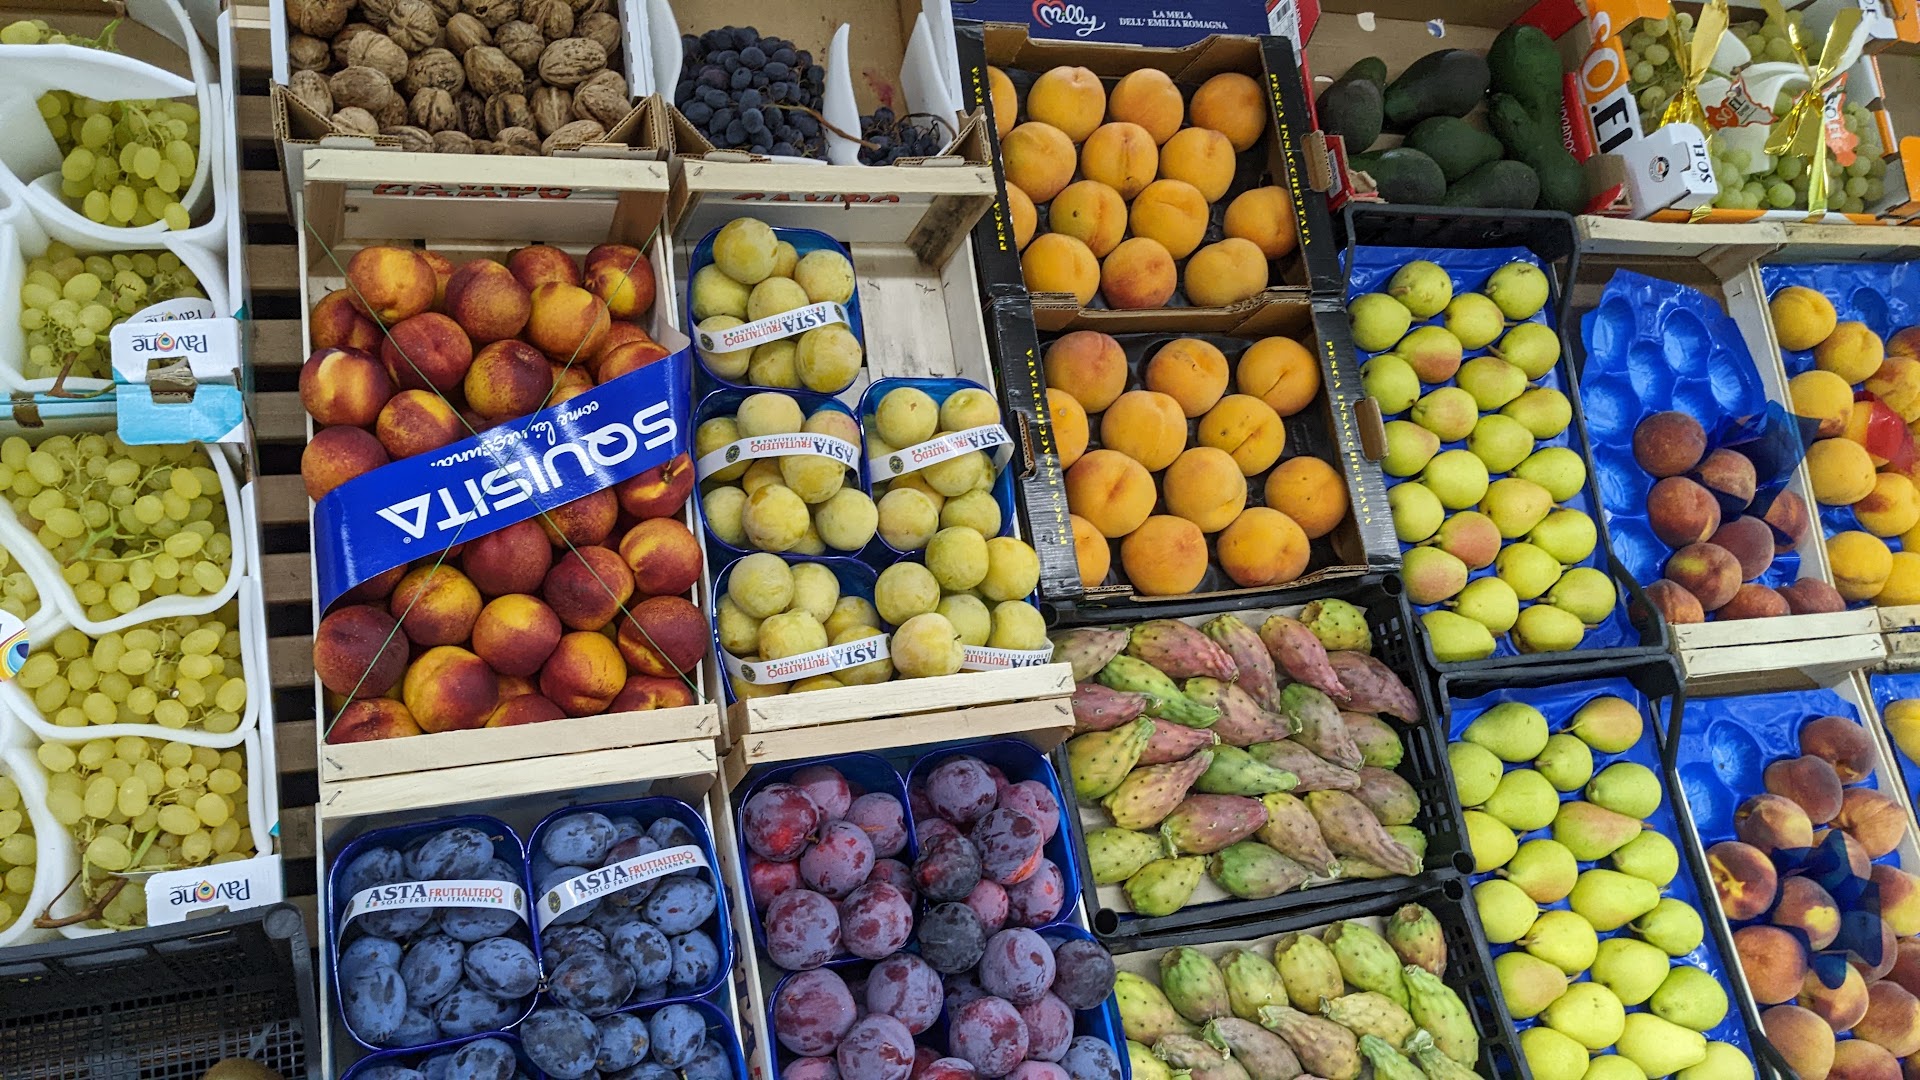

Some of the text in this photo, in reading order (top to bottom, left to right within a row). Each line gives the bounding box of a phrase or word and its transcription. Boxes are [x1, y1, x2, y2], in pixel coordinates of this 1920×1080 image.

[1148, 18, 1181, 28] EMILIA
[1182, 19, 1229, 30] ROMAGNA
[1152, 10, 1193, 19] LA MELA
[1269, 73, 1285, 119] PESCA
[1280, 123, 1311, 246] INSACCHETTATA
[735, 321, 767, 335] ITALIANA
[769, 313, 795, 325] FRUTTA
[782, 309, 827, 333] ASTA
[557, 401, 599, 426] come
[530, 420, 556, 446] lei
[800, 436, 827, 444] FRUTTA
[1325, 340, 1372, 525] PESCA INSACCHETTATA
[813, 441, 853, 463] ASTA
[1025, 347, 1067, 545] PESCA INSACCHETTATA
[829, 644, 878, 668] ASTA
[846, 642, 866, 652] SOLO
[779, 655, 814, 667] ITALIANA
[573, 864, 629, 896] ASTA
[587, 861, 684, 896] SOLO FRUTTA ITALIANA
[366, 883, 427, 904] ASTA
[381, 898, 405, 906] SOLO
[409, 896, 444, 904] FRUTTA
